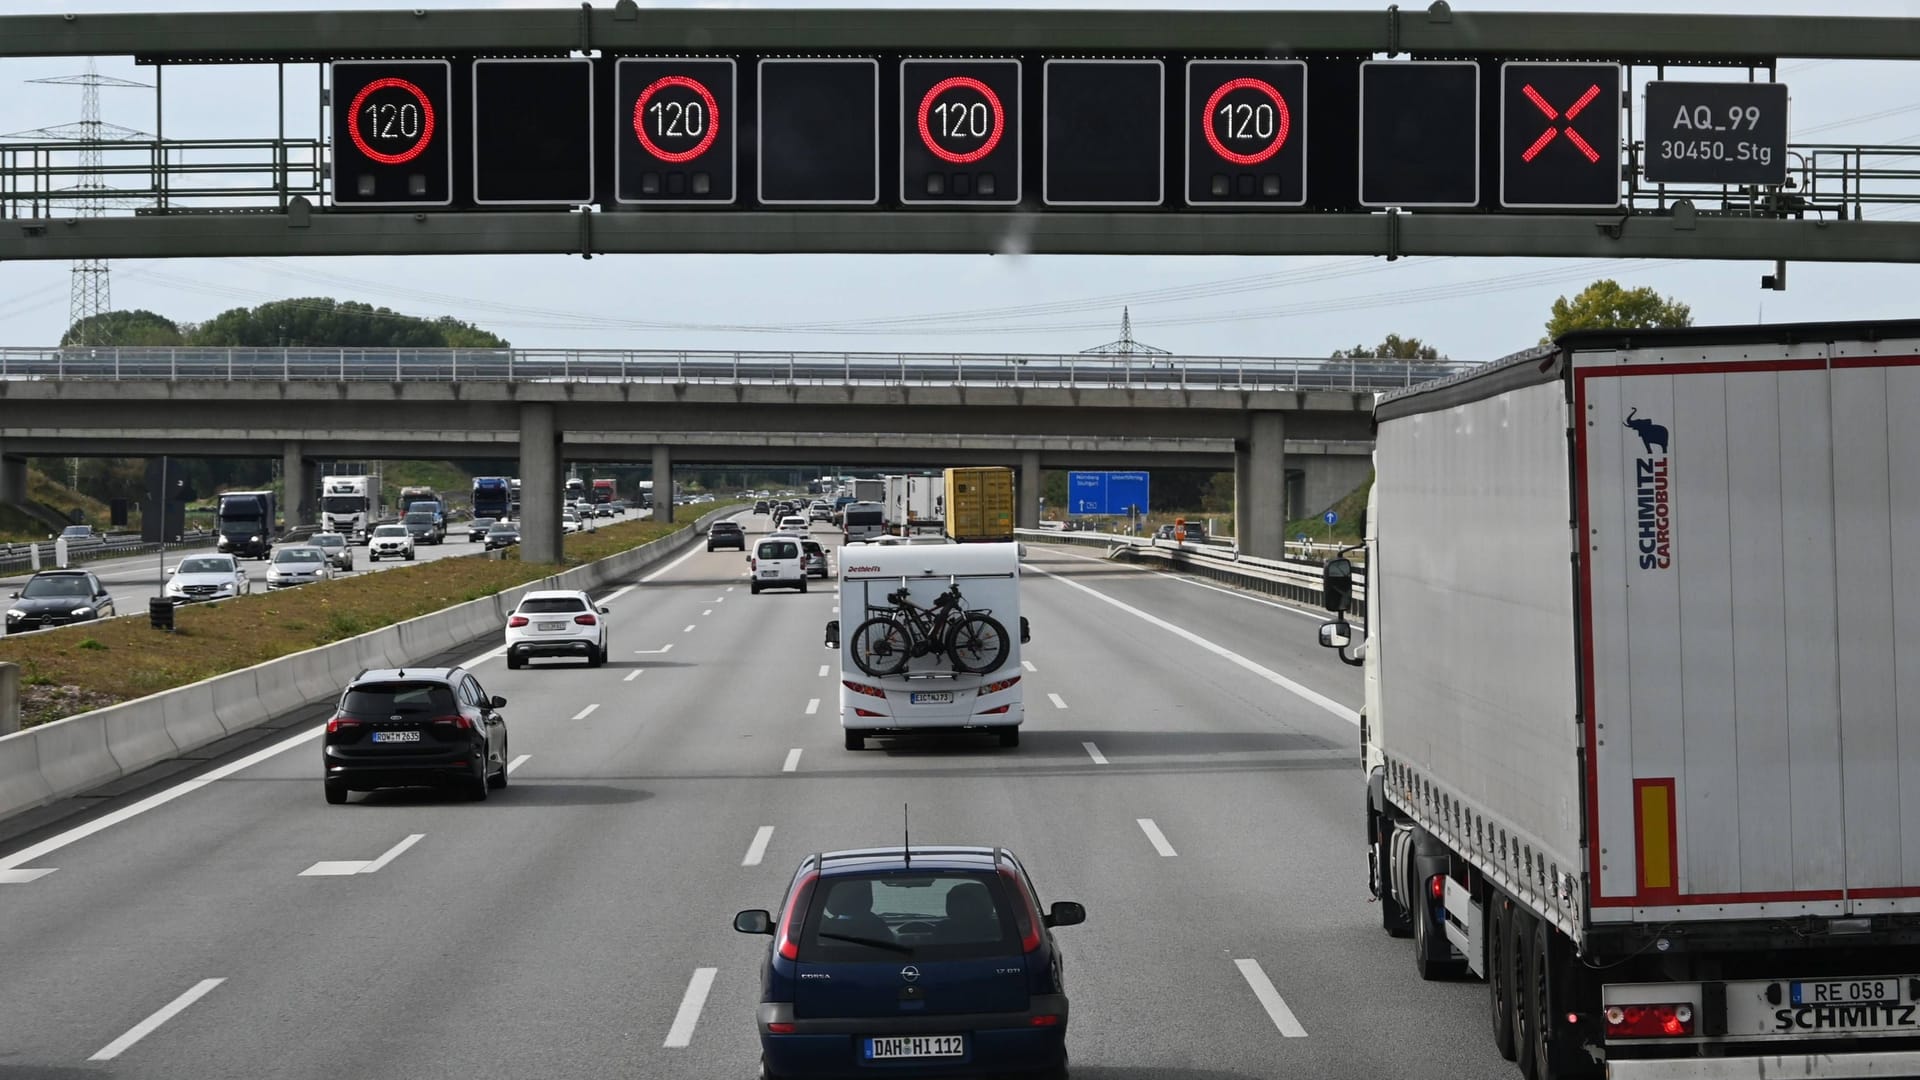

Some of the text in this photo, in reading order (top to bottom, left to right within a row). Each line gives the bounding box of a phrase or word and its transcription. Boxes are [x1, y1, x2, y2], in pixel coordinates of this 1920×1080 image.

[365, 103, 418, 138] 120
[650, 101, 702, 136] 120
[934, 102, 988, 138] 120
[1219, 103, 1274, 139] 120
[1673, 105, 1761, 131] AQ_99
[1661, 140, 1771, 165] 30450_Stg
[1636, 458, 1657, 570] SCHMITZ
[1654, 457, 1671, 569] CARGOBULL
[1815, 982, 1885, 1001] RE 058
[1775, 1005, 1916, 1029] SCHMITZ
[874, 1037, 962, 1056] DAH HI 112
